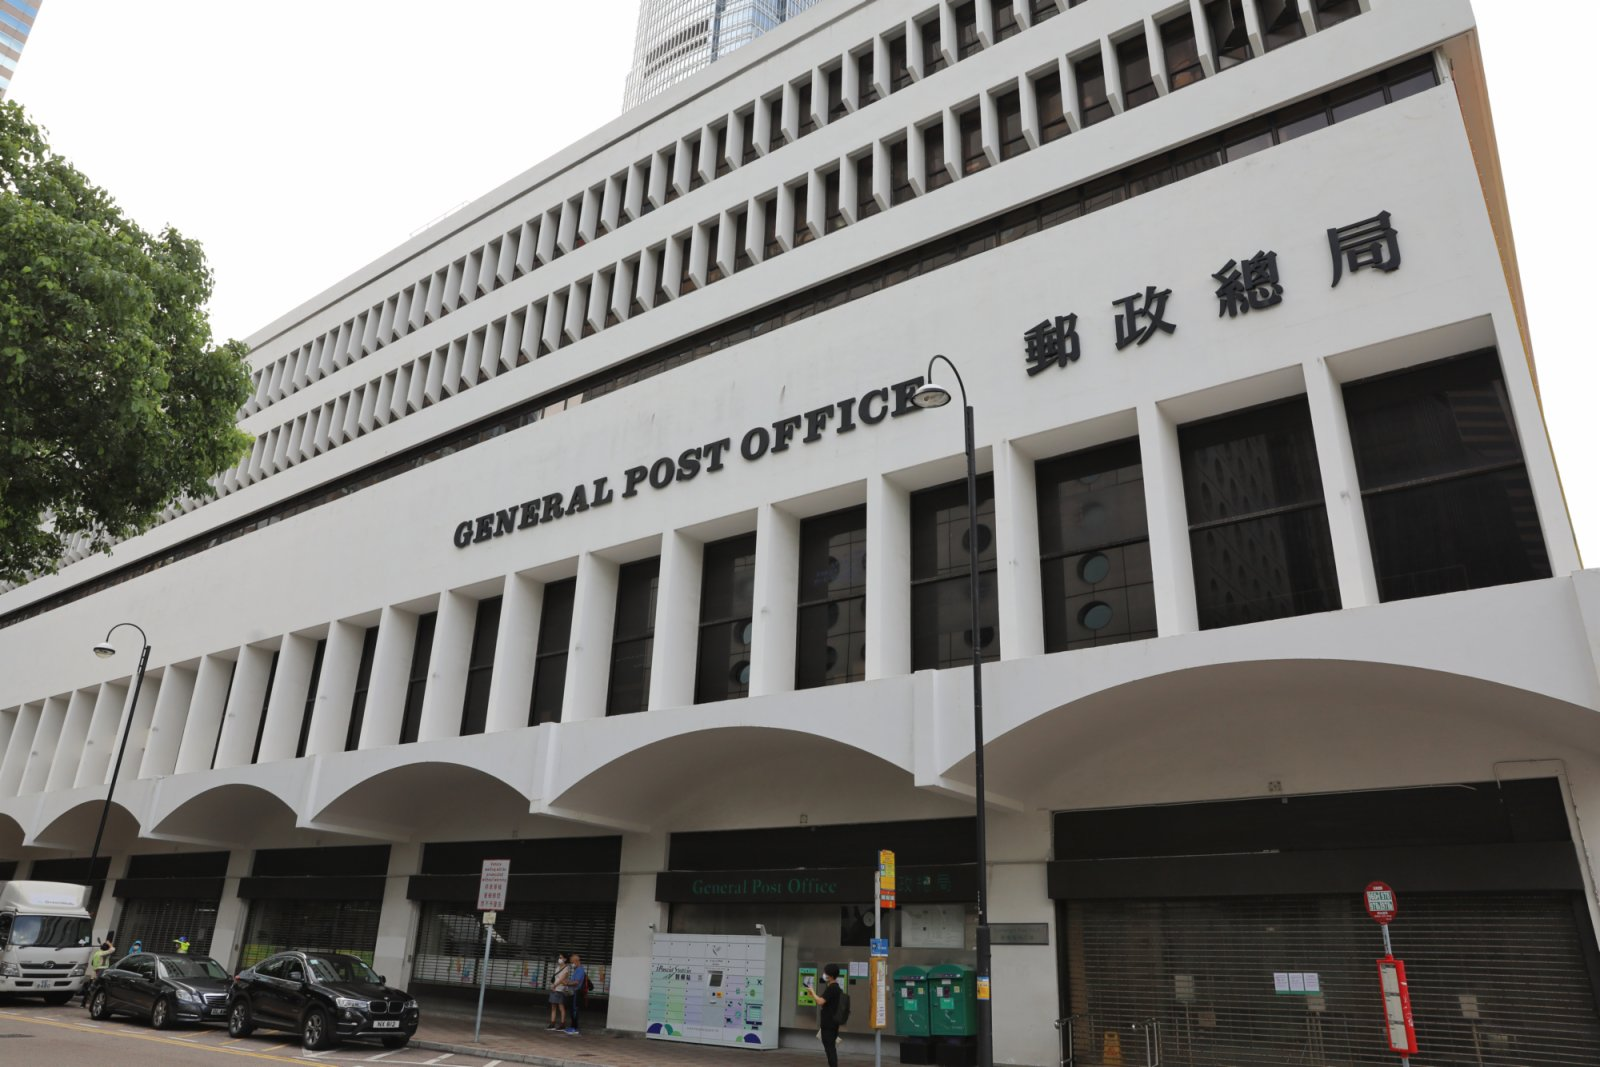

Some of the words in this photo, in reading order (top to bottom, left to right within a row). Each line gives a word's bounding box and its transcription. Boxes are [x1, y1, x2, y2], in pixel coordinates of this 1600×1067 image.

[1023, 209, 1402, 378] 郵政總局
[453, 476, 614, 549] GENERAL
[621, 437, 731, 498] POST
[740, 375, 927, 462] OFFICE
[691, 879, 748, 895] General
[752, 879, 783, 894] Post
[788, 877, 838, 894] Office
